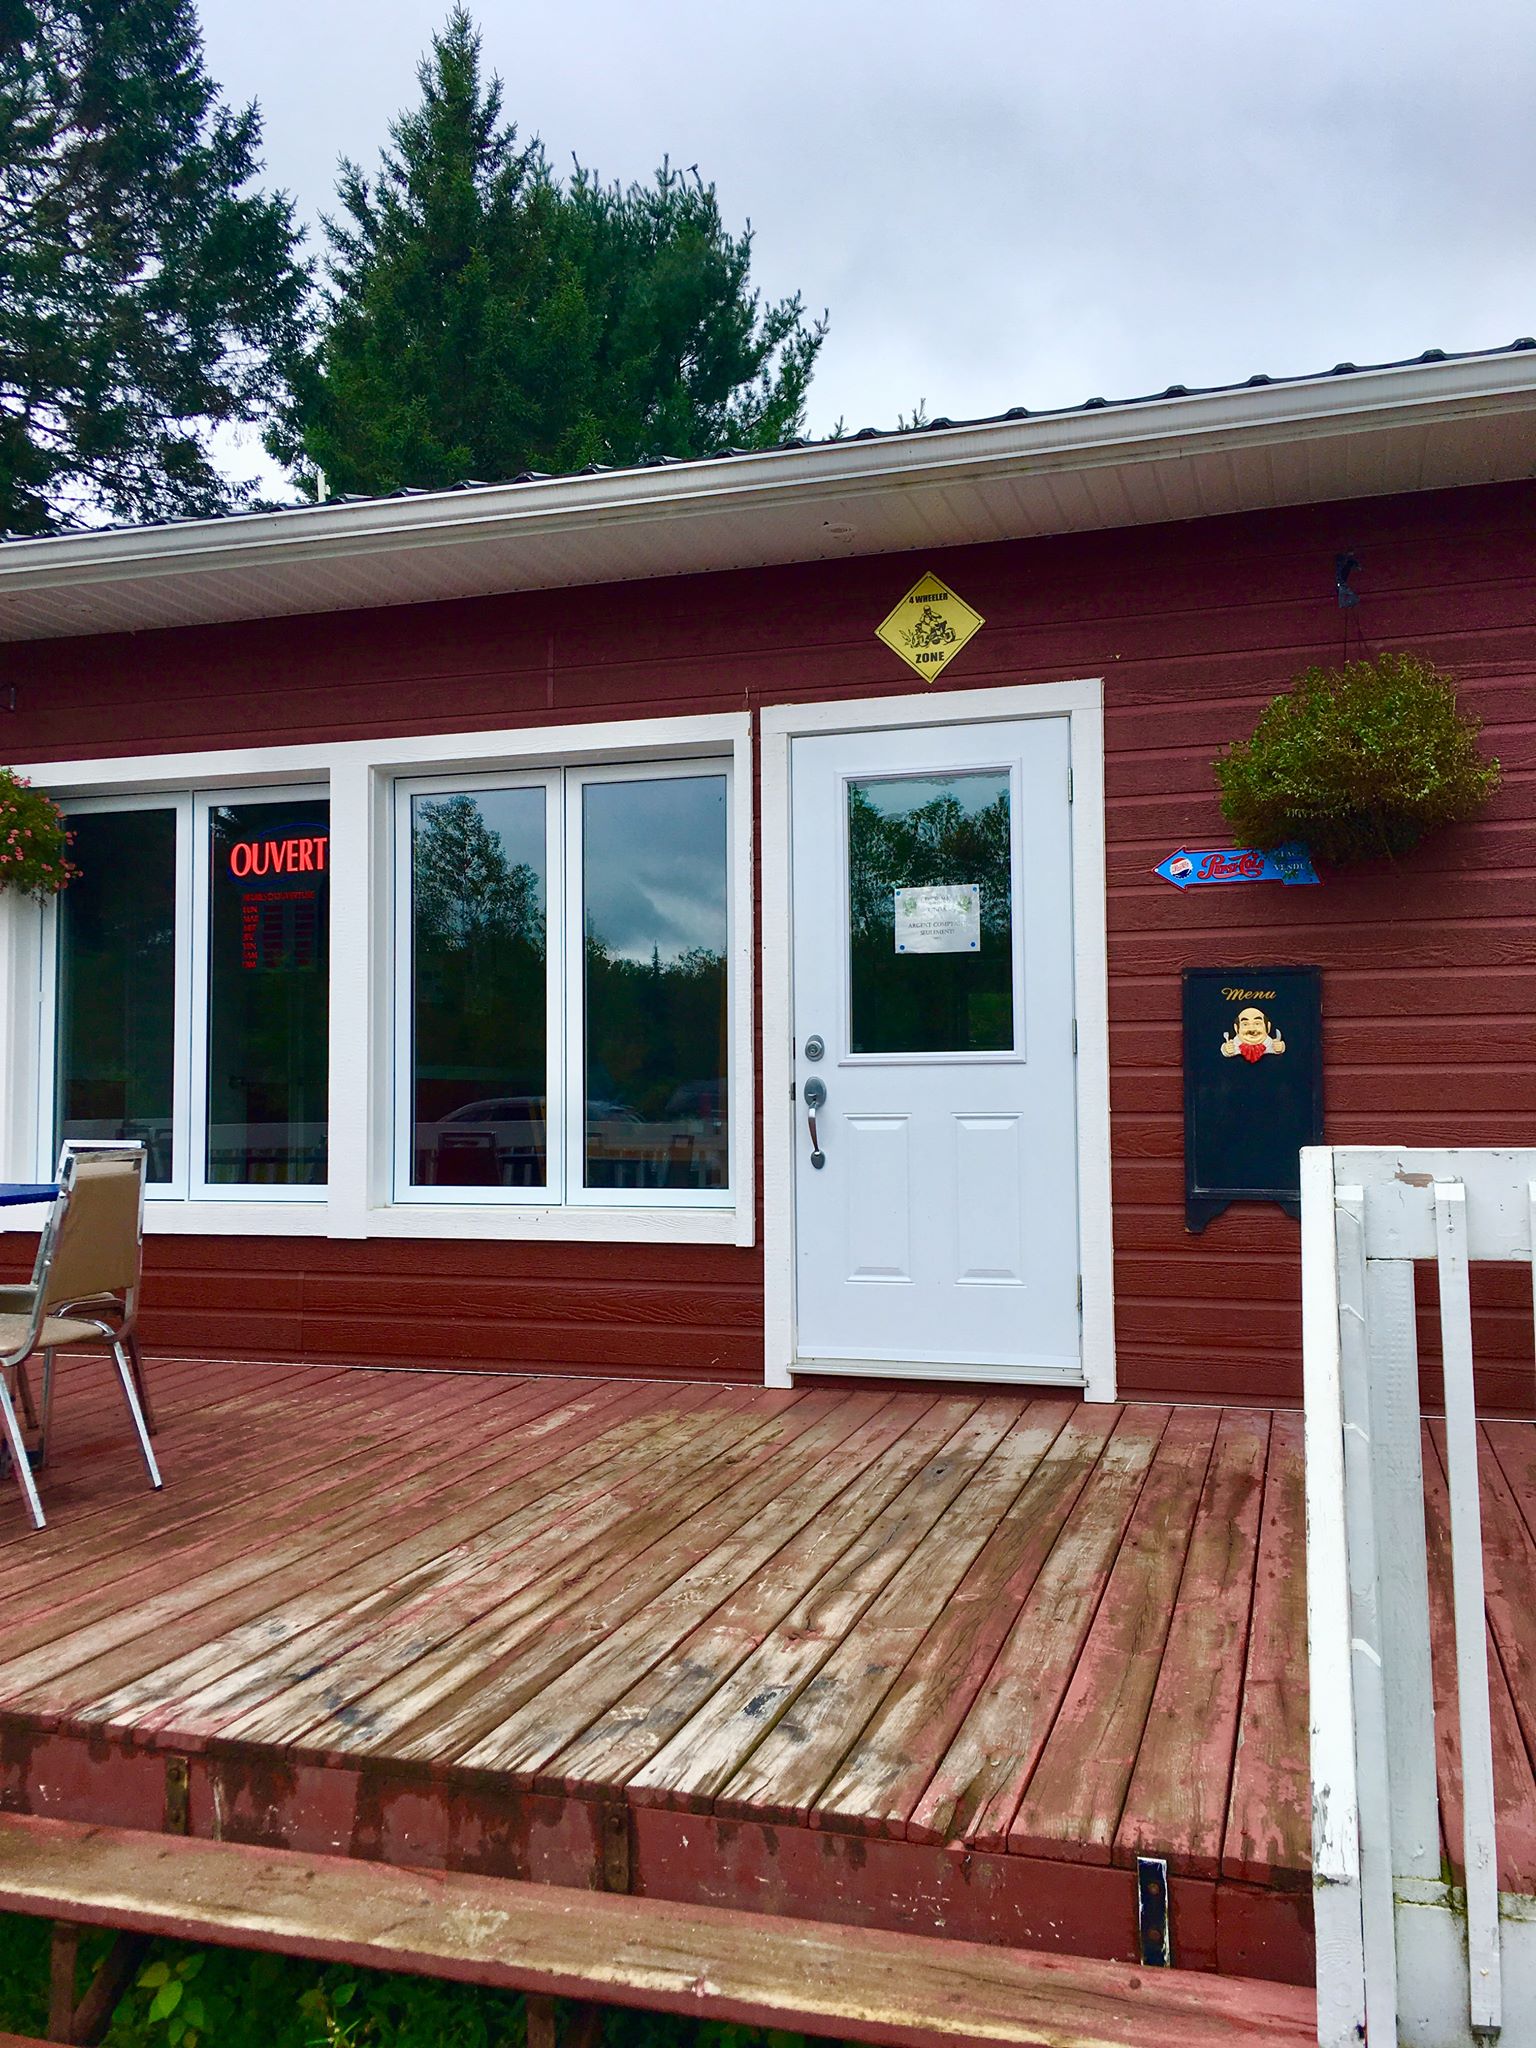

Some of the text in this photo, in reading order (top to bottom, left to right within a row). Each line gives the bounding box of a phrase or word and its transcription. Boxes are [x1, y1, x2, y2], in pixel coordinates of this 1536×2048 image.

[908, 593, 948, 604] 4 WHEELER
[915, 651, 945, 664] ZONE
[230, 837, 328, 877] OUVERT
[1221, 987, 1277, 1001] Menu
